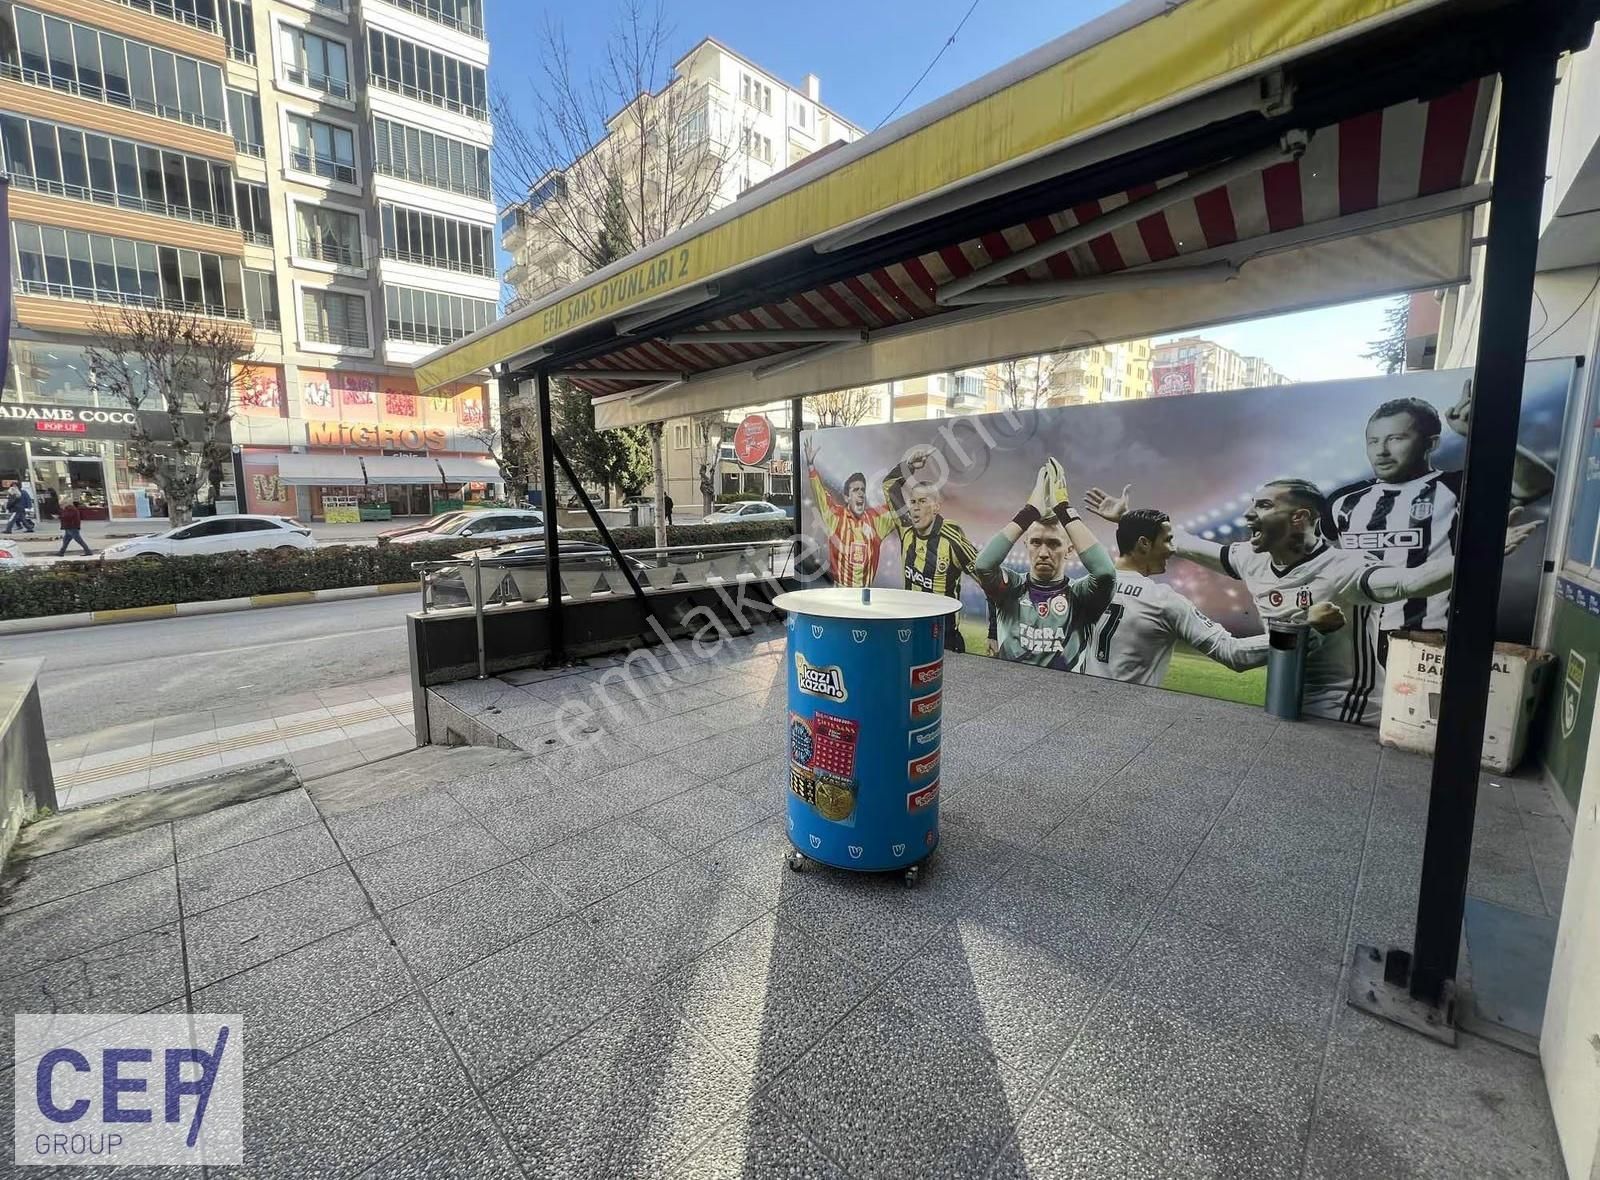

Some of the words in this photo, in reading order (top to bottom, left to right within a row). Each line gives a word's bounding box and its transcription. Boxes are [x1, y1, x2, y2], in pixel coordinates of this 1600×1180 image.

[566, 291, 597, 328] ŞANS
[600, 256, 674, 309] OYUNLARI
[678, 249, 689, 278] 2
[1342, 531, 1420, 548] BEKO
[1020, 636, 1064, 653] PIZZA
